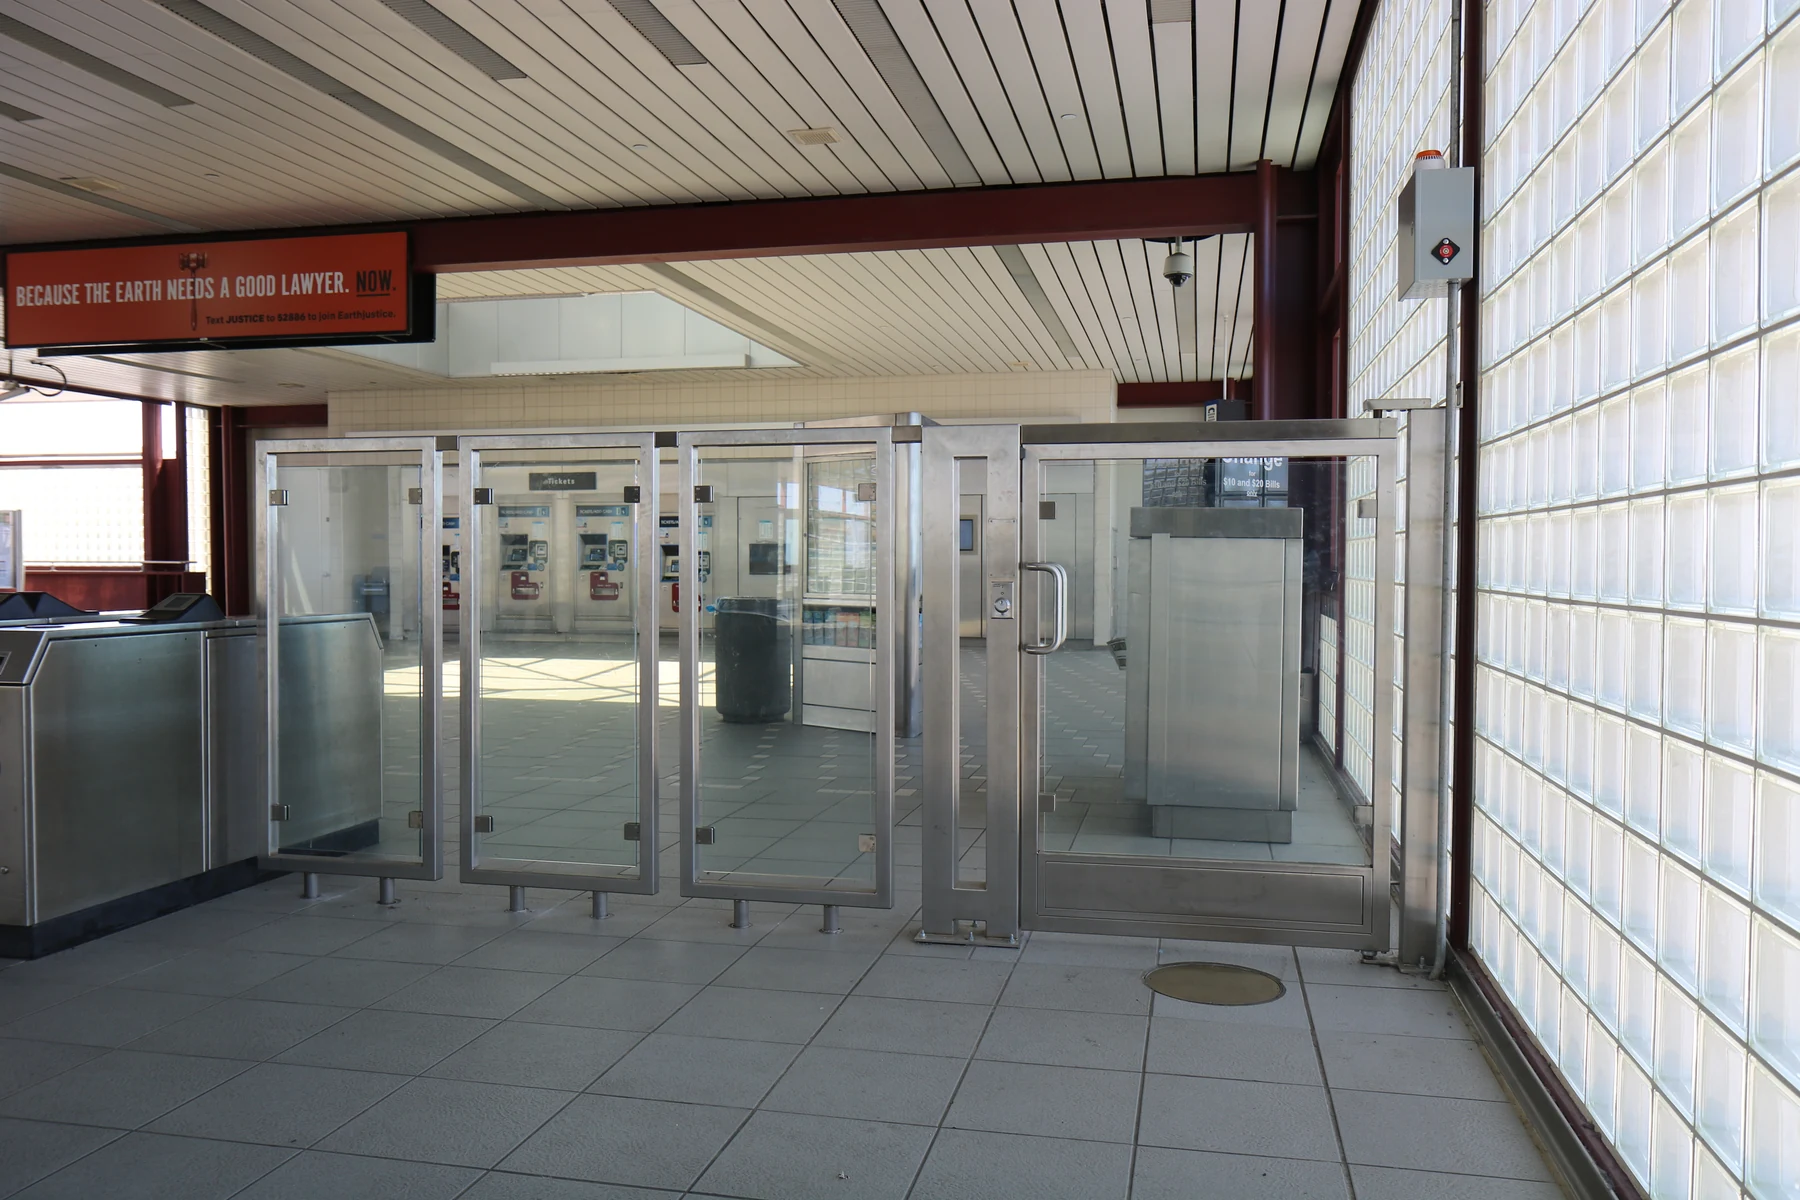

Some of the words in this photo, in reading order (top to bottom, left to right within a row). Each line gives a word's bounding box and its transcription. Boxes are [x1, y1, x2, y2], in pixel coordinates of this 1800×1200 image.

[16, 283, 80, 307] BECAUSE
[84, 282, 111, 304] THE
[115, 279, 162, 303] EARTH
[167, 277, 214, 301] NEEDS
[220, 276, 230, 298] A
[235, 275, 276, 298] GOOD
[281, 271, 350, 296] LAWYER.
[355, 270, 397, 293] NOW.
[206, 315, 224, 324] Text
[226, 314, 265, 324] JUSTICE
[277, 313, 306, 322] 52886
[307, 313, 317, 321] to
[318, 310, 336, 322] join
[337, 309, 396, 322] Earthjustice.
[548, 477, 575, 485] Tickets
[1223, 477, 1236, 487] $10
[1237, 478, 1251, 487] and
[1251, 478, 1264, 488] $20
[1265, 480, 1280, 489] Bills
[1246, 490, 1258, 498] only
